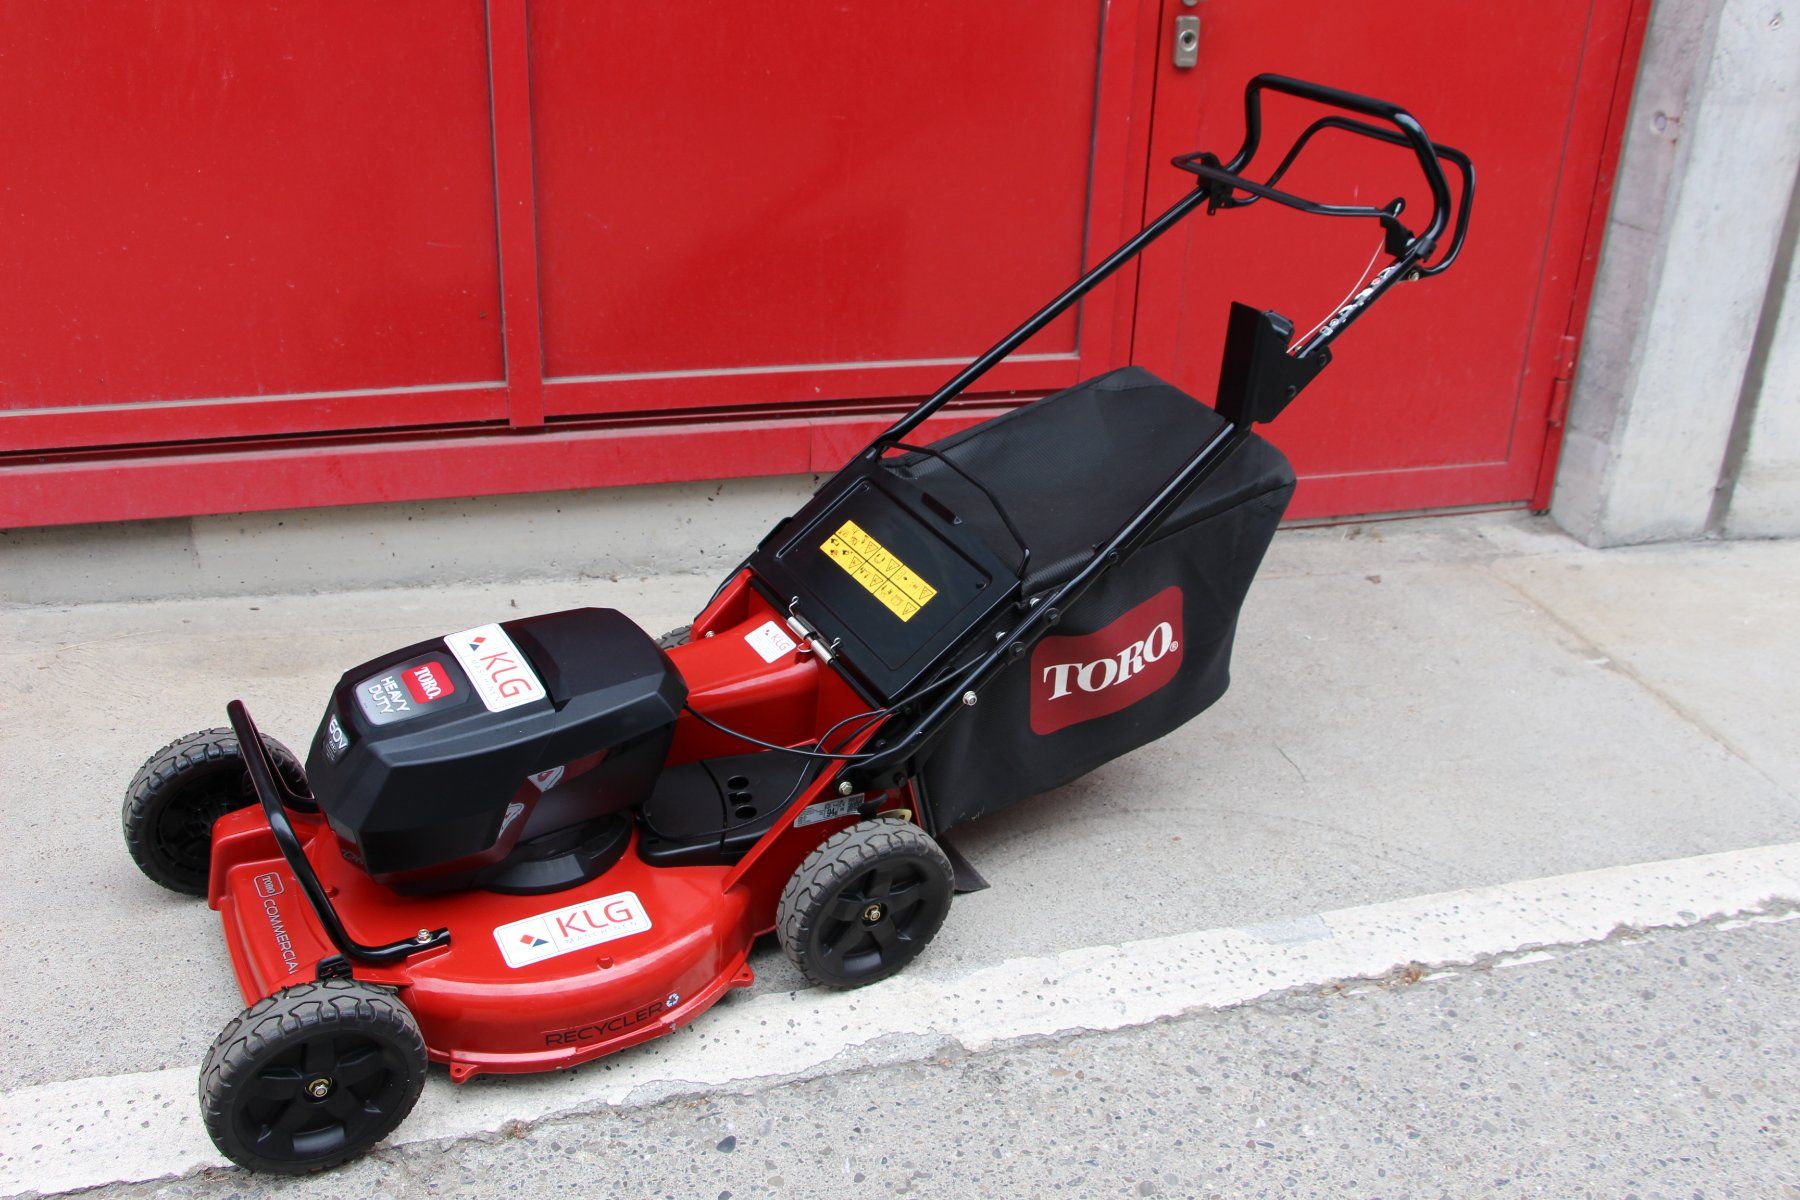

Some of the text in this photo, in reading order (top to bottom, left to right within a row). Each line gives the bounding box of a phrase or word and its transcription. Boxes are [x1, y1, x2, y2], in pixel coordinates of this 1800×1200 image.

[414, 666, 442, 697] TORO
[480, 651, 532, 699] KLG
[368, 684, 394, 714] DUTY
[380, 676, 410, 711] HEAVY
[329, 718, 347, 749] 60V
[555, 900, 634, 938] KLG
[545, 1001, 664, 1046] RECYCLER
